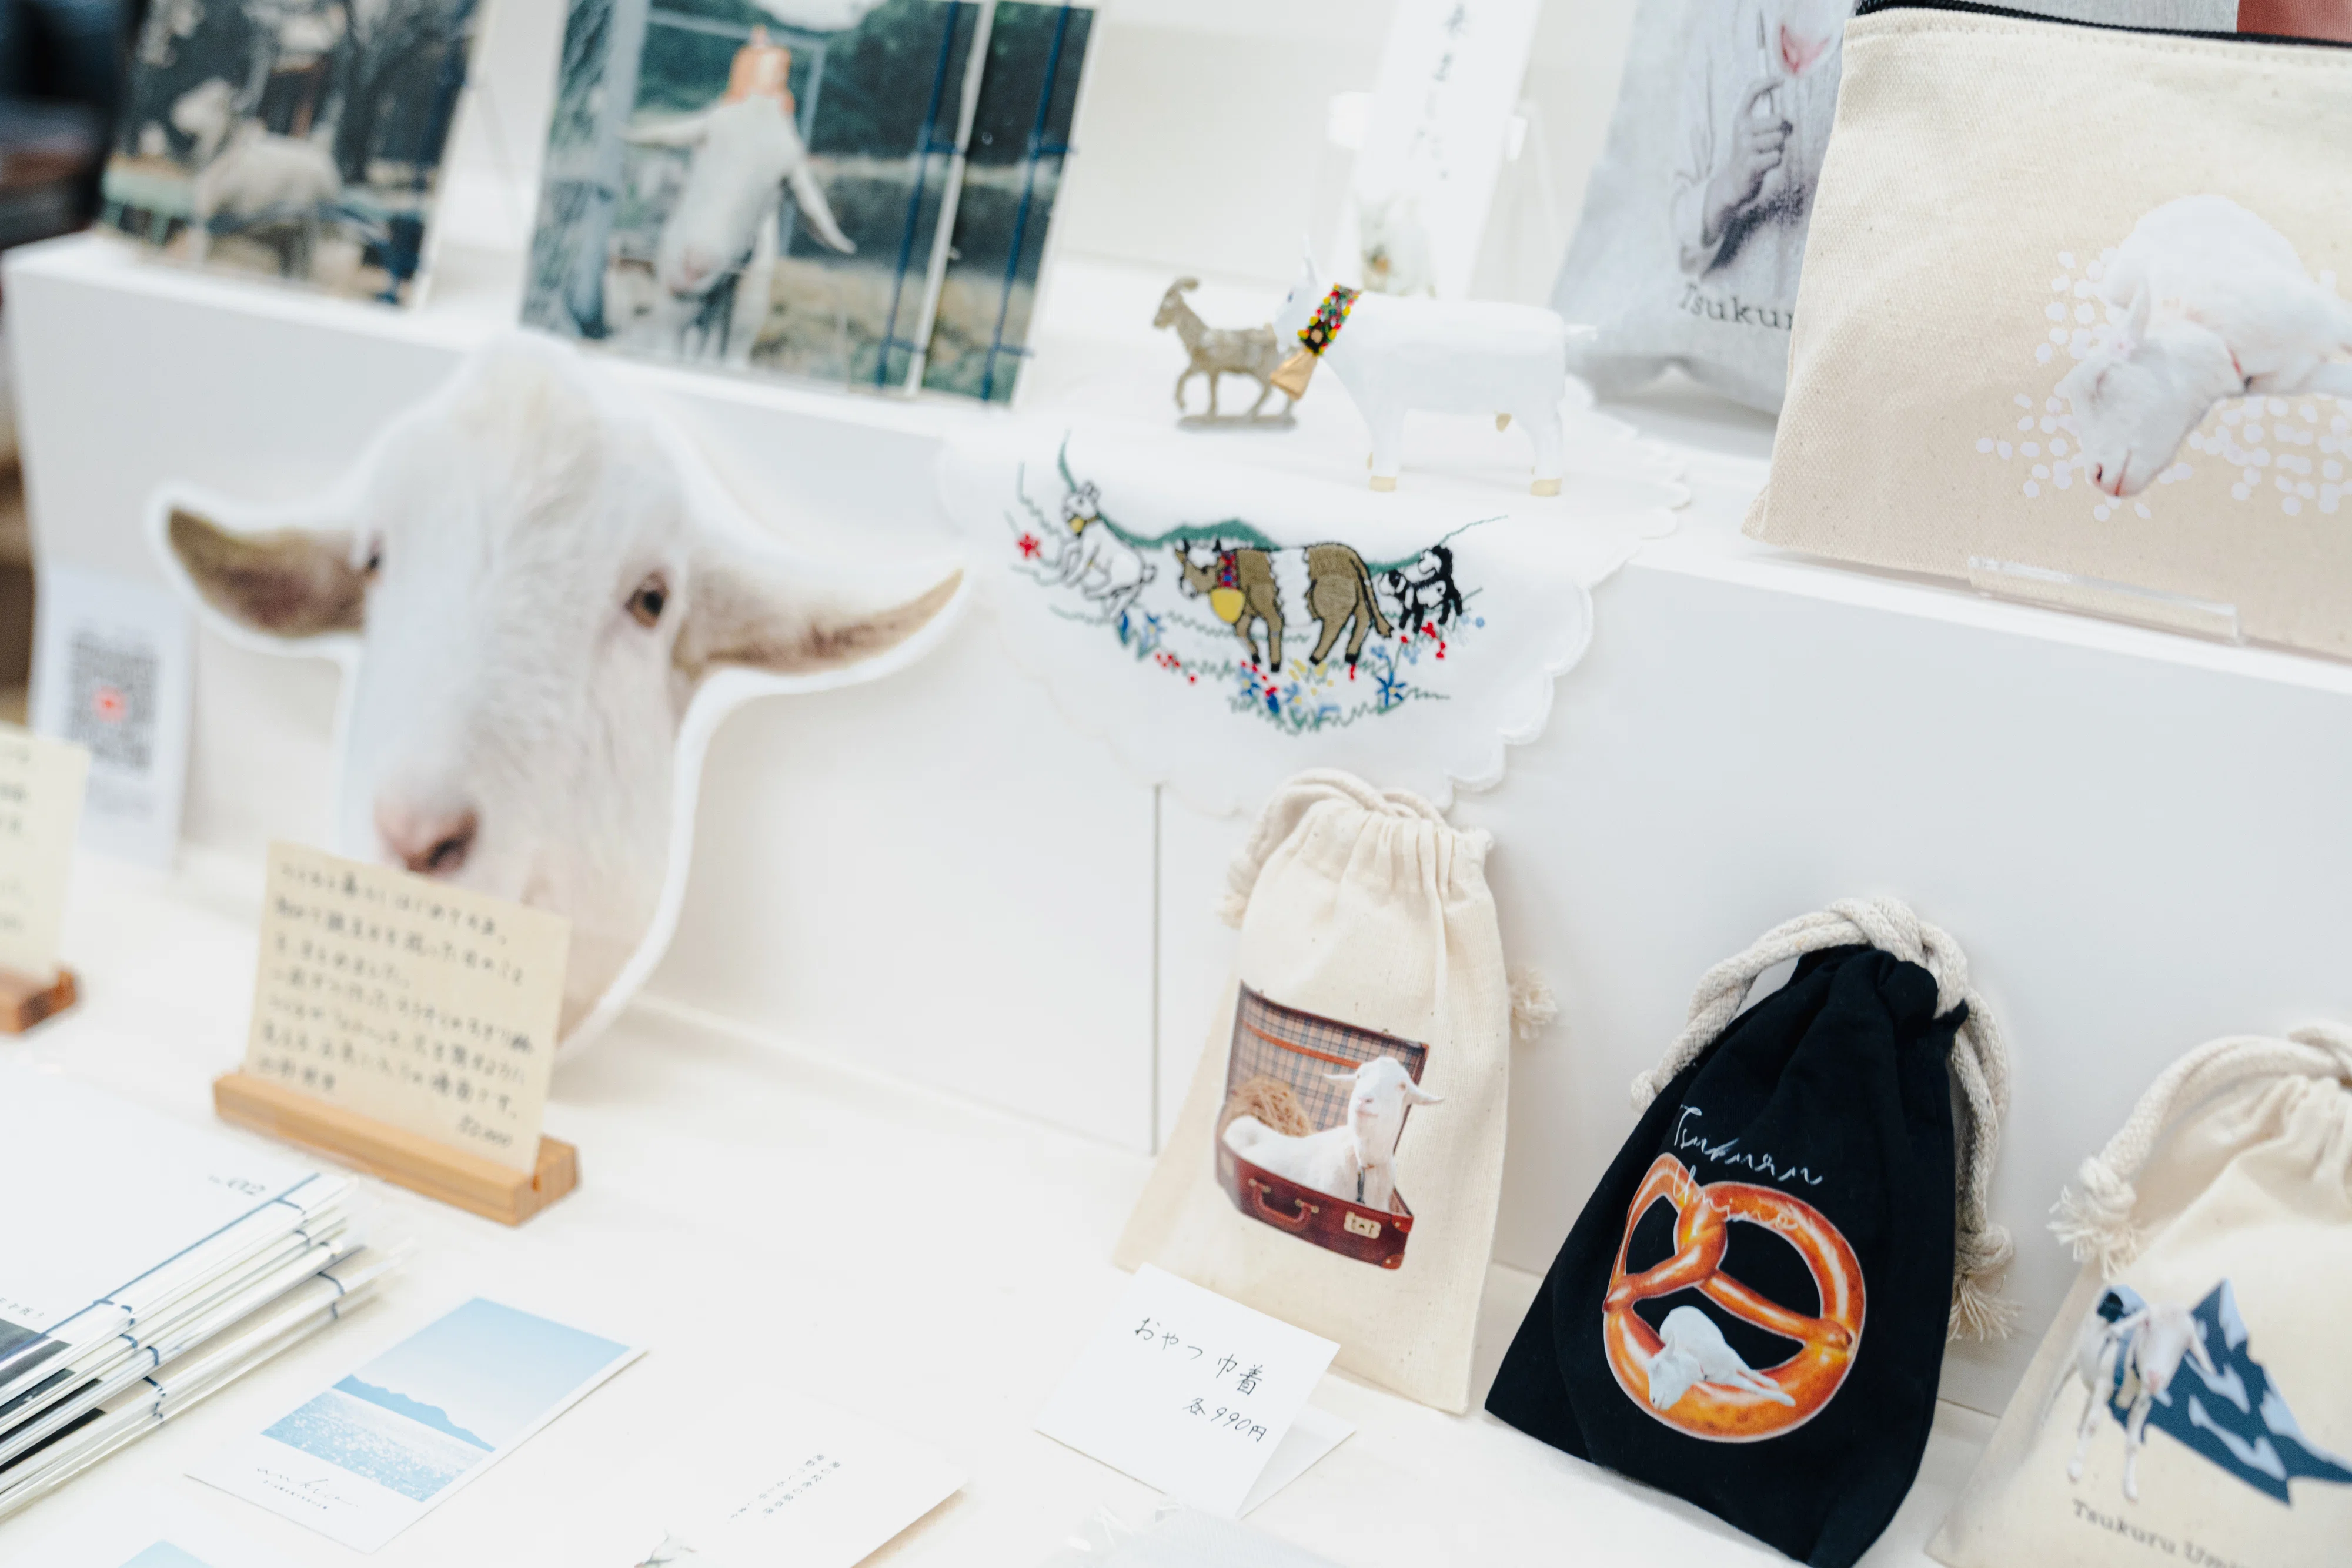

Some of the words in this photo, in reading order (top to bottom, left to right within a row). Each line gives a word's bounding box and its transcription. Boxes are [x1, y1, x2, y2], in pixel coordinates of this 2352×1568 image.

[1134, 1317, 1264, 1396] おやつ巾着
[1182, 1397, 1267, 1443] 各990円
[2072, 1497, 2177, 1554] Tsukuru
